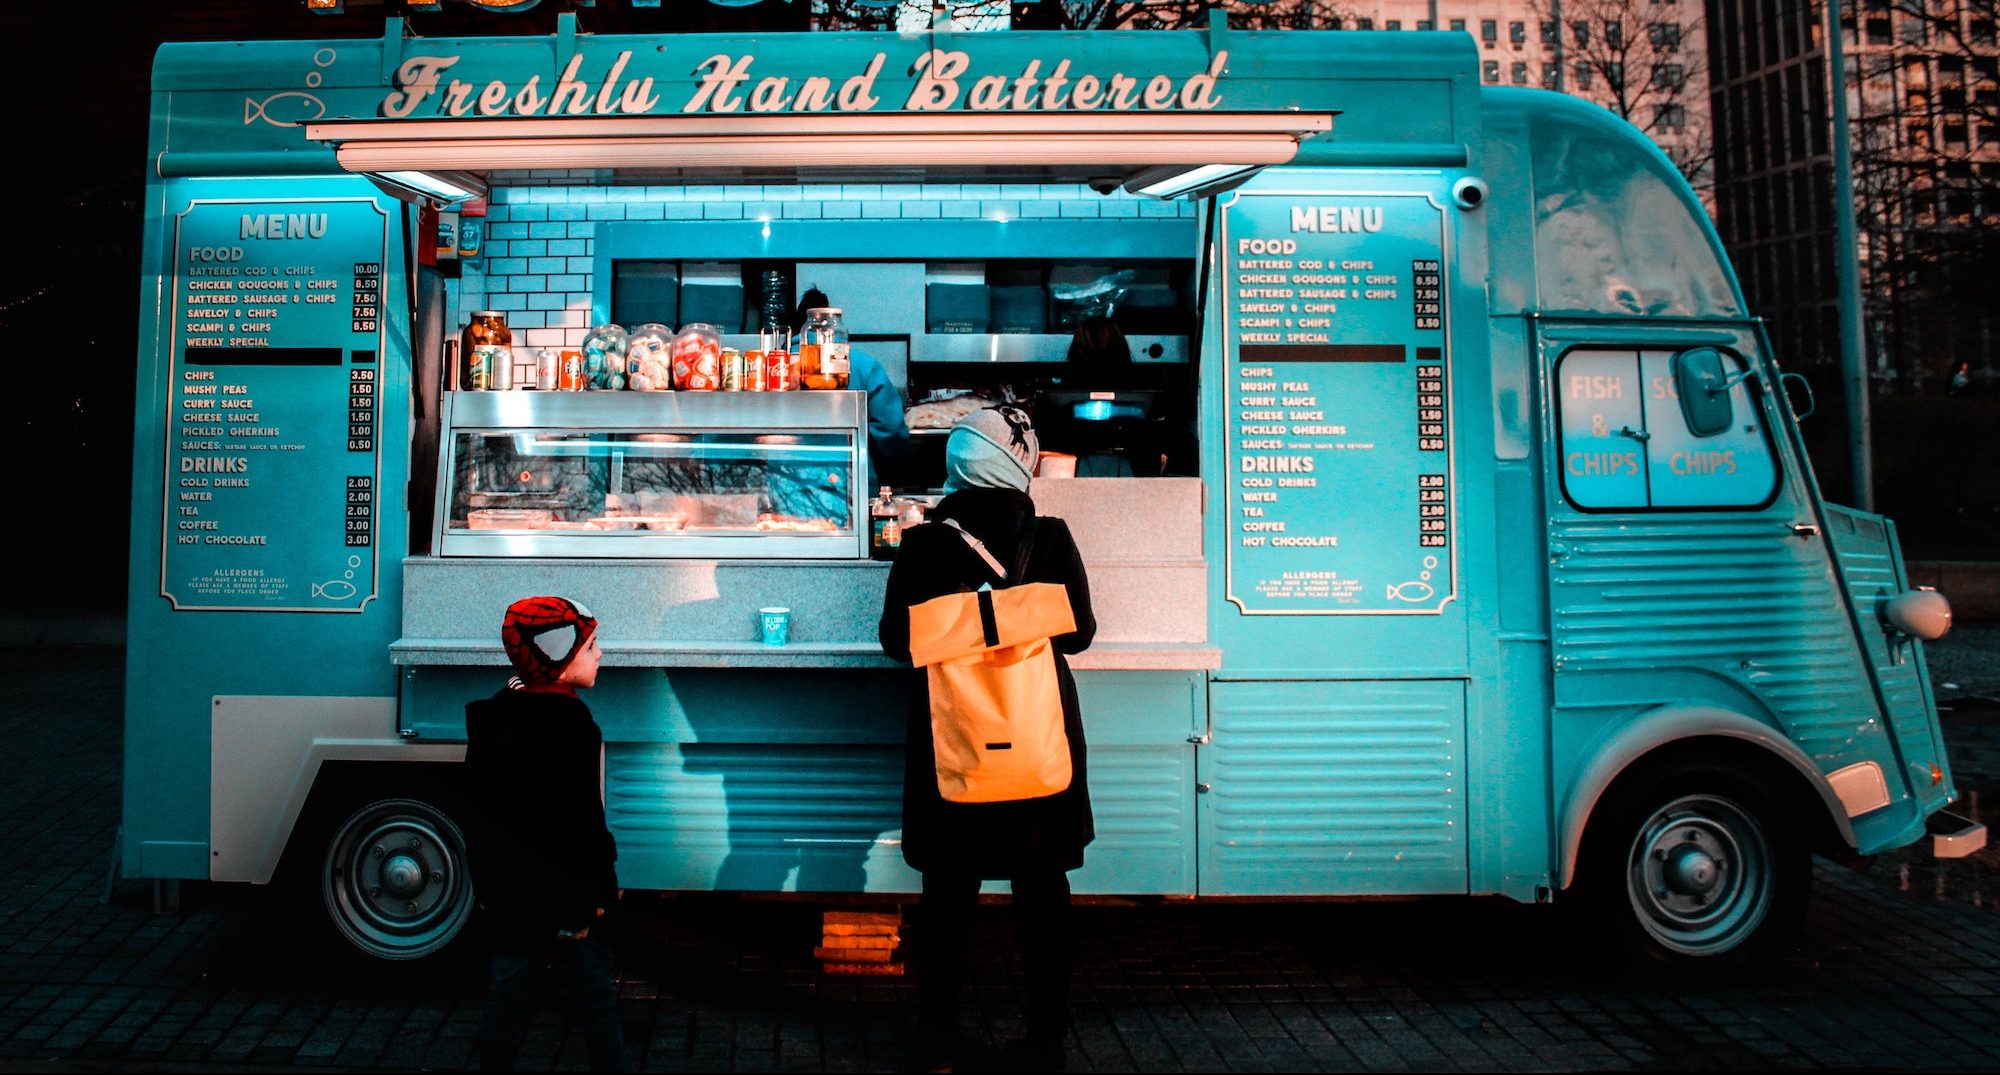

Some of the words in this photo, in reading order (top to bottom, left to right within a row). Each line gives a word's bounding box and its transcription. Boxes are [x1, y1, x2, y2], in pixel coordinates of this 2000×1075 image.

[680, 52, 887, 114] Hand
[903, 48, 1229, 111] Battered
[1291, 204, 1383, 232] MENU
[241, 212, 328, 239] MENU
[1239, 238, 1297, 255] FOOD
[190, 246, 244, 262] FOOD
[189, 266, 240, 276] BATTERED
[244, 266, 268, 276] COD
[285, 265, 316, 276] CHIPS
[354, 264, 379, 275] 10.00
[1238, 259, 1294, 270] BATTERED
[1298, 259, 1323, 270] COD
[1341, 260, 1373, 270] CHIPS
[1239, 273, 1288, 284] CHICKEN
[1365, 275, 1397, 284] CHIPS
[188, 280, 233, 290] CHICKEN
[294, 280, 301, 289] &
[307, 279, 338, 289] CHIPS
[355, 279, 377, 289] 8.50
[187, 294, 239, 304] BATTERED
[243, 294, 288, 304] SAUSAGE
[293, 294, 300, 303] &
[305, 293, 336, 303] CHIPS
[354, 293, 376, 304] 7.50
[1239, 287, 1295, 299] BATTERED
[1298, 288, 1347, 299] SAUSAGE
[1365, 289, 1397, 299] CHIPS
[187, 308, 230, 318] SAVELOY
[234, 308, 242, 318] &
[247, 308, 278, 318] CHIPS
[353, 307, 376, 317] 7.50
[1239, 302, 1286, 313] SAVELOY
[1304, 303, 1337, 313] CHIPS
[186, 322, 224, 333] SCAMPI
[228, 323, 236, 332] &
[241, 322, 271, 332] CHIPS
[353, 320, 376, 331] 8.50
[1239, 317, 1281, 328] SCAMPI
[1298, 317, 1331, 328] CHIPS
[186, 337, 224, 347] WEEKLY
[229, 337, 269, 348] SPECIAL
[1240, 332, 1281, 343] WEEKLY
[1287, 332, 1330, 343] SPECIAL
[184, 371, 215, 381] CHIPS
[351, 370, 374, 380] 3.50
[1240, 367, 1274, 377] CHIPS
[183, 385, 218, 394] MUSHY
[222, 384, 248, 395] PEAS
[351, 384, 372, 394] 1.50
[1240, 381, 1277, 392] MUSHY
[1282, 381, 1310, 392] PEAS
[1570, 375, 1623, 400] FISH
[183, 399, 216, 409] CURRY
[221, 399, 253, 409] SAUCE
[351, 397, 372, 408] 1.50
[1241, 396, 1276, 406] CURRY
[1281, 396, 1317, 407] SAUCE
[182, 412, 223, 422] CHEESE
[227, 413, 260, 422] SAUCE
[351, 411, 371, 422] 1.50
[1241, 410, 1284, 421] CHEESE
[1289, 410, 1324, 421] SAUCE
[1241, 424, 1287, 435] PICKLED
[1292, 424, 1347, 435] GHERKINS
[1591, 413, 1609, 438] &
[182, 426, 225, 436] PICKLED
[229, 426, 280, 437] GHERKINS
[350, 426, 371, 436] 1.00
[181, 440, 222, 450] SAUCES:
[349, 439, 371, 450] 0.50
[181, 456, 248, 473] DRINKS
[1241, 455, 1315, 473] DRINKS
[1567, 451, 1640, 477] CHIPS
[1669, 450, 1738, 476] CHIPS
[180, 477, 209, 487] COLD
[214, 477, 250, 487] DRINKS
[348, 478, 370, 488] 2.00
[1241, 477, 1273, 488] COLD
[1278, 477, 1317, 487] DRINKS
[180, 491, 213, 501] WATER
[348, 492, 371, 502] 2.00
[1242, 491, 1278, 502] WATER
[179, 506, 199, 516] TEA
[347, 506, 370, 516] 2.00
[1242, 506, 1265, 517] TEA
[179, 520, 219, 530] COFFEE
[346, 520, 369, 531] 3.00
[1242, 521, 1286, 532] COFFEE
[178, 534, 200, 544] HOT
[205, 535, 267, 545] CHOCOLATE
[346, 535, 369, 545] 3.00
[1242, 536, 1267, 547] HOT
[1271, 536, 1338, 547] CHOCOLATE
[213, 569, 265, 577] ALLERGENS
